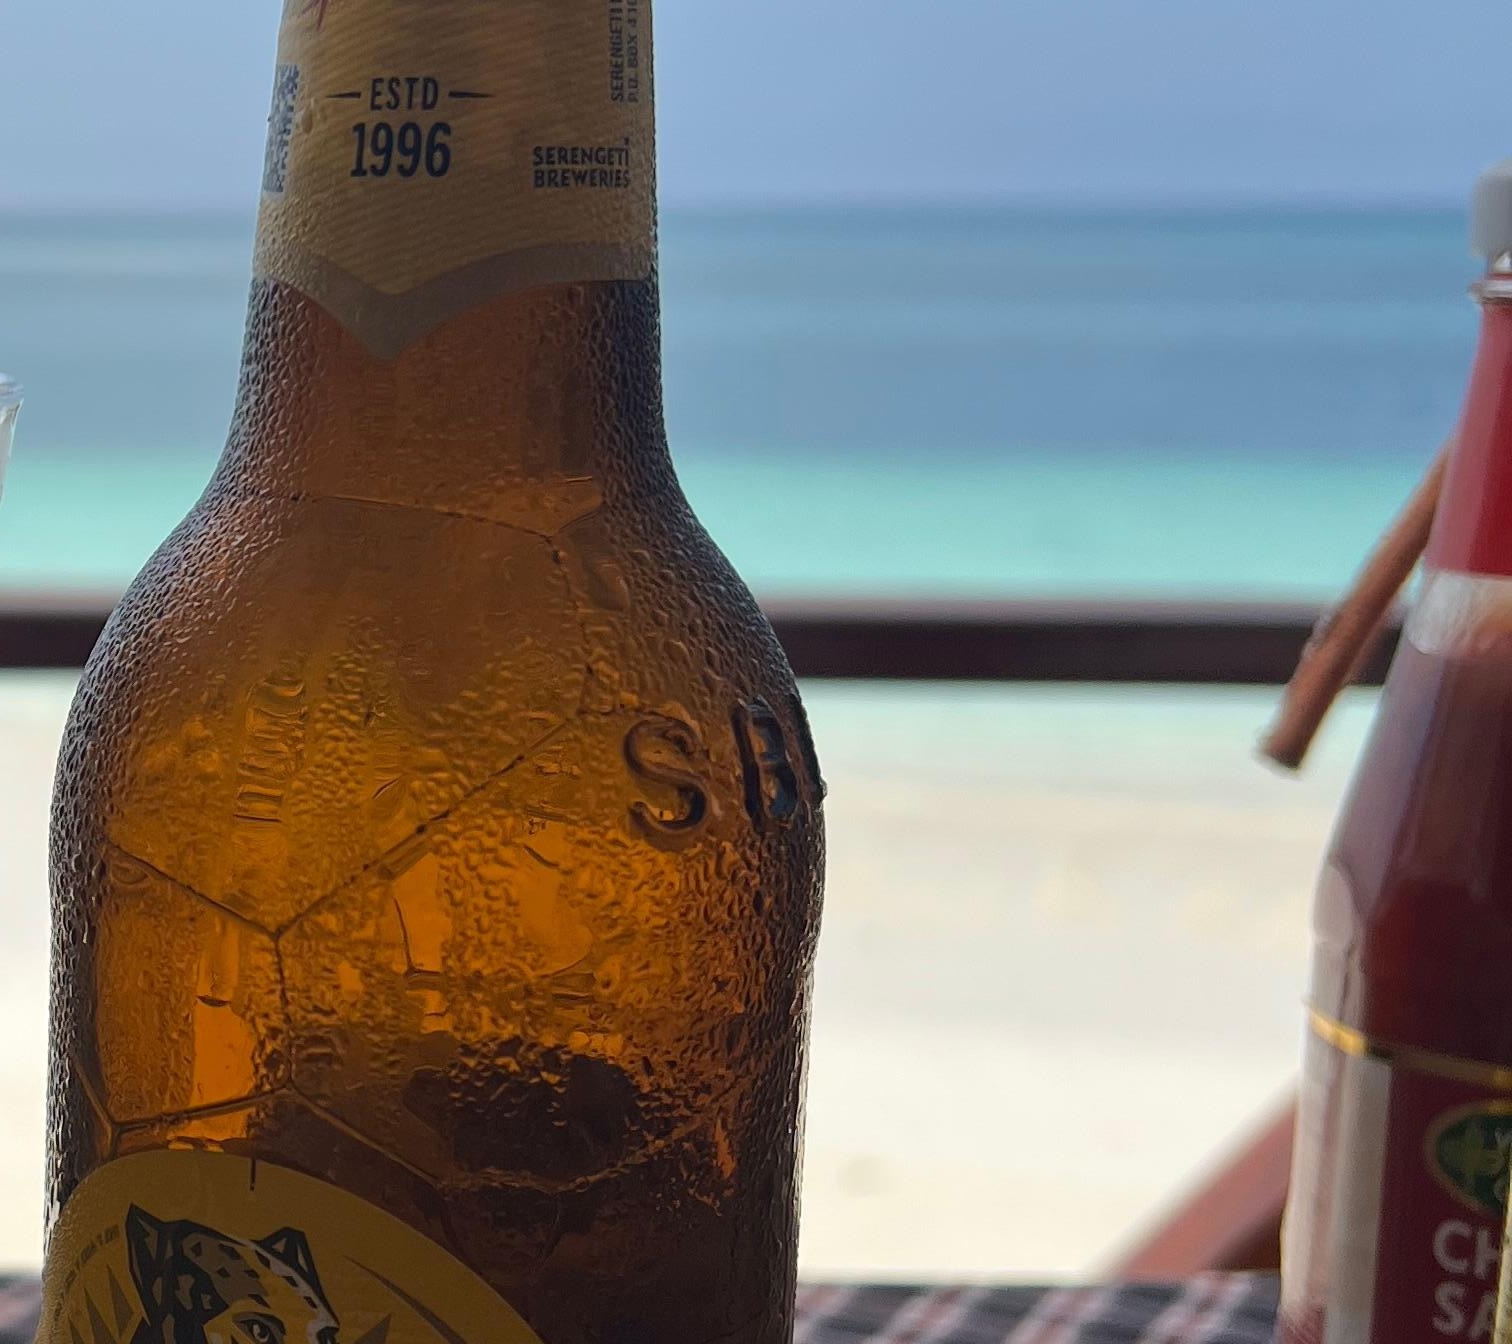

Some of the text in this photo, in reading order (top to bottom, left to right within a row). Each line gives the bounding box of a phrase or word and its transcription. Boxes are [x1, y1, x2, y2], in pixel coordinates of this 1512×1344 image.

[609, 7, 624, 102] SERENGETI
[626, 35, 638, 67] BOX
[370, 77, 440, 111] ESTD
[350, 121, 452, 177] 1996
[532, 142, 630, 167] SERENGETI
[533, 168, 631, 189] BREWERIES
